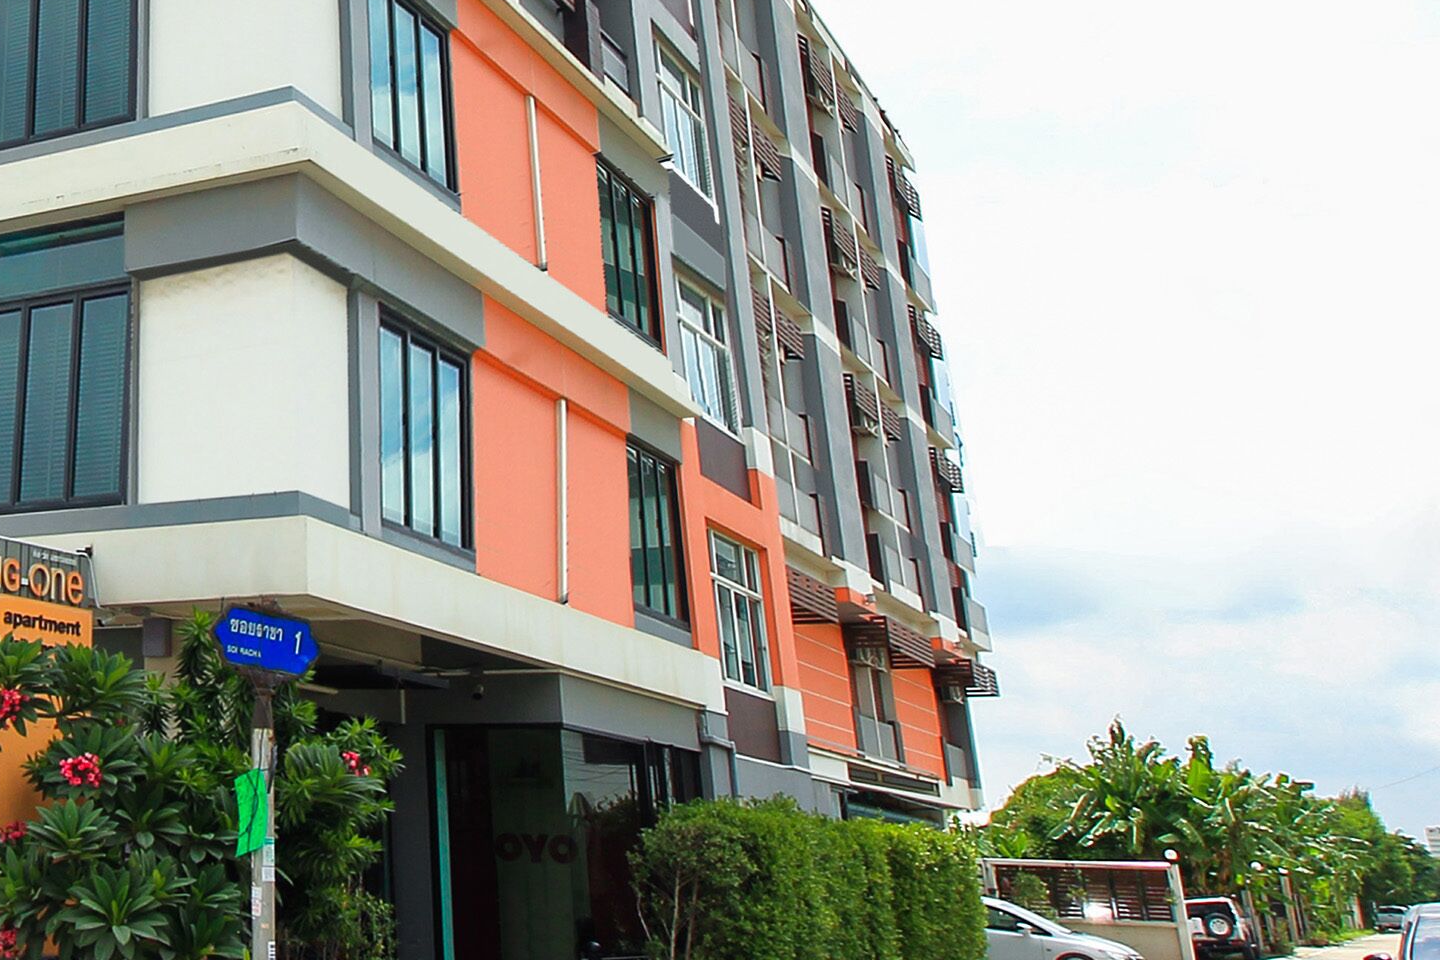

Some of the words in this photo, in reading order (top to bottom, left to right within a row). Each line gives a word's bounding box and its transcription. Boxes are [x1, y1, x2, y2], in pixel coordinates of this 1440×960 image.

[3, 609, 81, 637] apartment
[294, 631, 303, 655] 1
[494, 832, 578, 864] OYO
